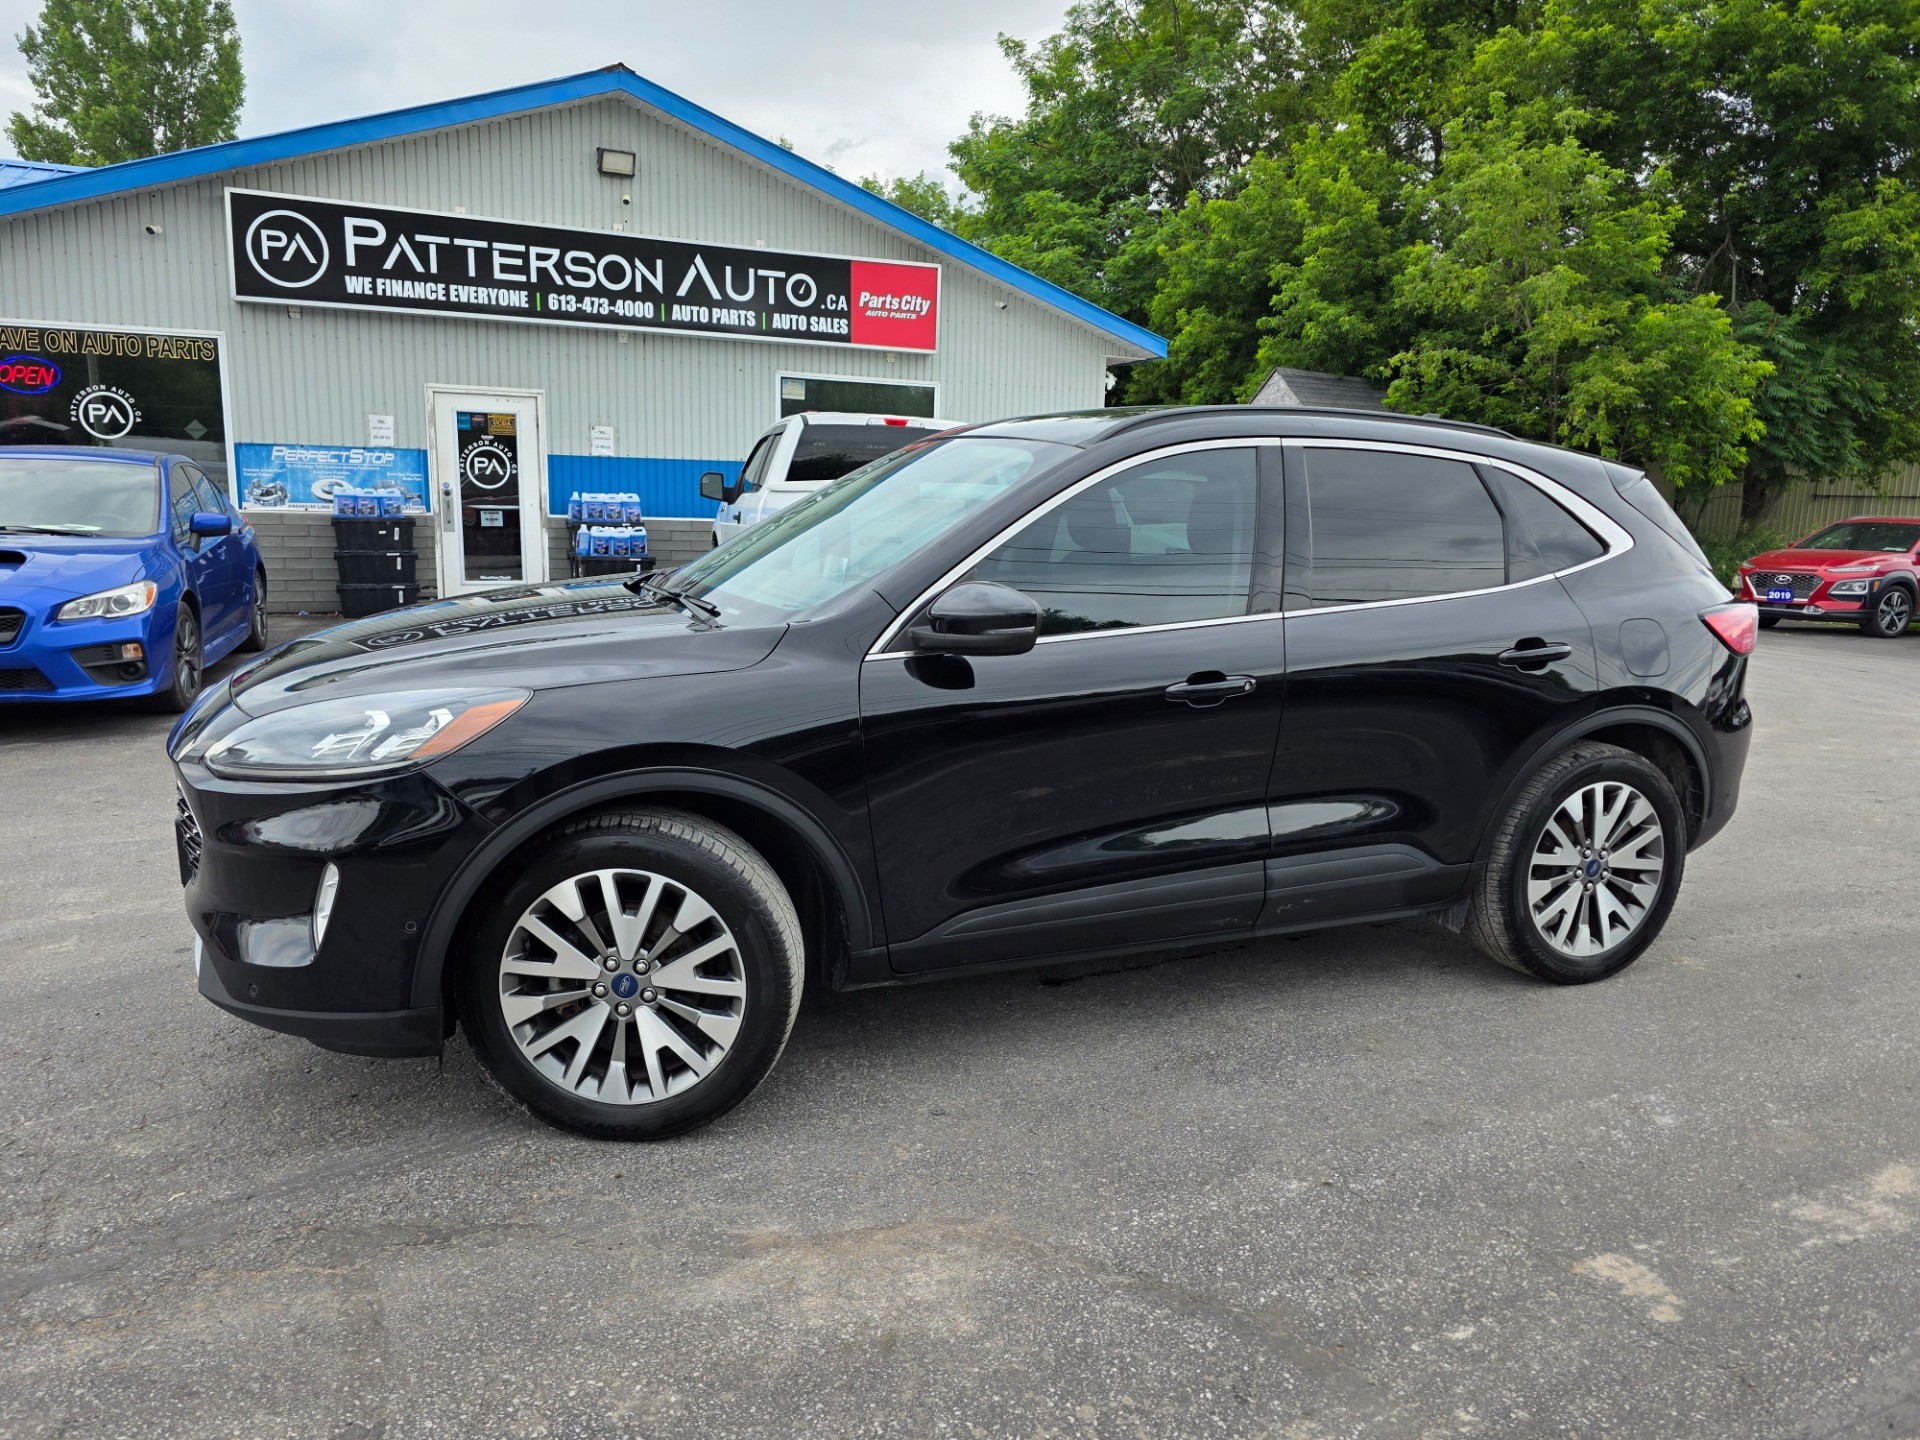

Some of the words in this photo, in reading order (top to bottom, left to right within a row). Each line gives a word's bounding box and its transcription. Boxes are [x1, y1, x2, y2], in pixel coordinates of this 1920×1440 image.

[260, 228, 318, 264] PA
[343, 216, 664, 295] PATTERSON
[344, 275, 374, 295] WE
[376, 279, 447, 300] FINANCE
[449, 284, 529, 308] EVERYONE
[548, 293, 654, 319] 613-473-4000
[671, 304, 709, 323] AUTO
[712, 308, 757, 328] PARTS
[772, 313, 807, 331] AUTO
[810, 316, 849, 335] SALES
[865, 310, 888, 318] AUTO
[890, 311, 917, 320] PARTS
[45, 330, 78, 353] ON
[82, 332, 142, 357] AUTO
[146, 336, 215, 361] PARTS
[0, 365, 55, 386] OPEN
[70, 384, 106, 421] PATTERSON
[88, 404, 126, 424] PA
[460, 440, 490, 473] PATTERSON
[474, 457, 504, 475] PA
[1768, 590, 1791, 600] 2019
